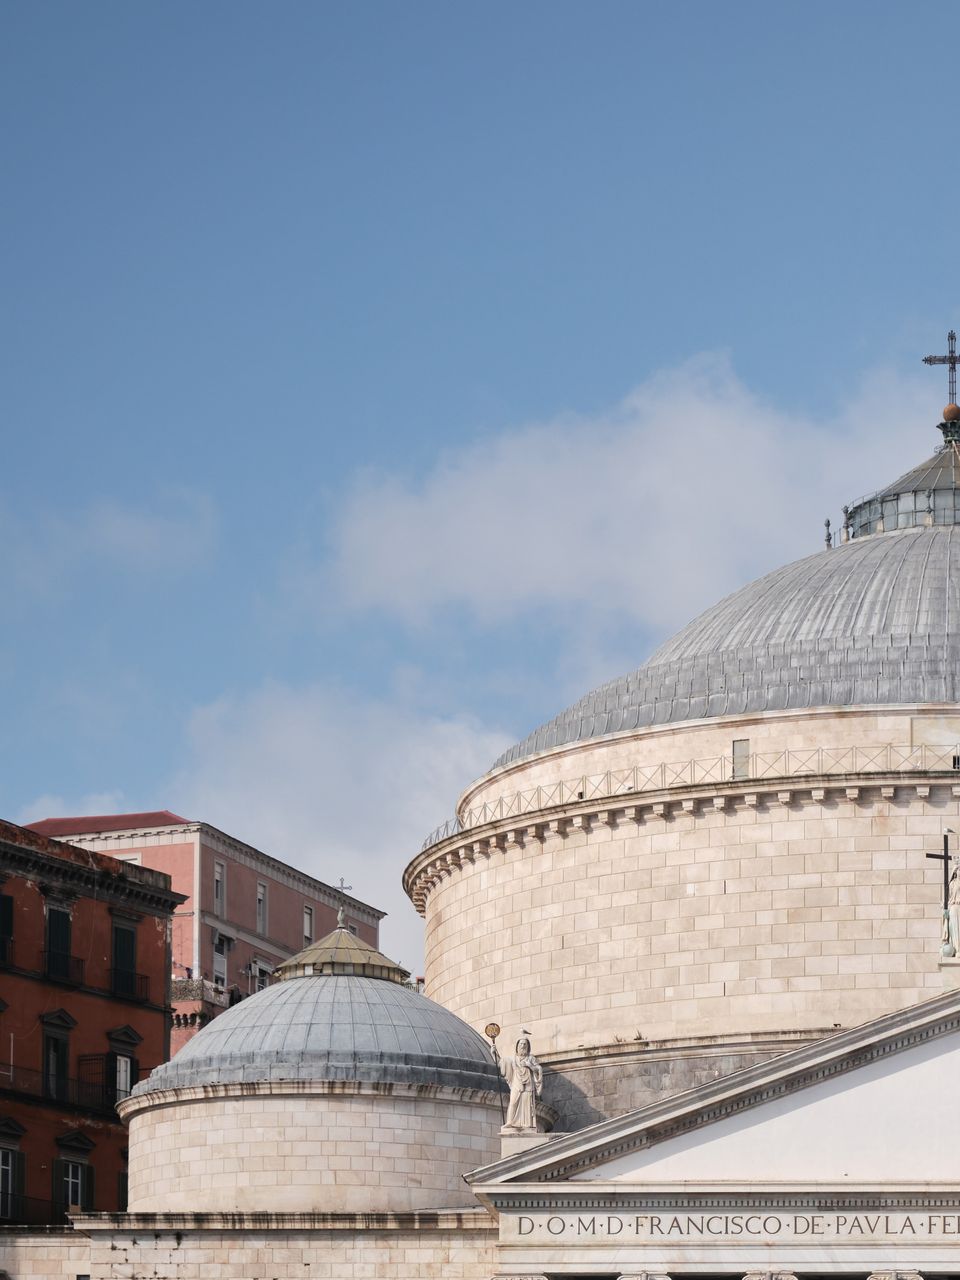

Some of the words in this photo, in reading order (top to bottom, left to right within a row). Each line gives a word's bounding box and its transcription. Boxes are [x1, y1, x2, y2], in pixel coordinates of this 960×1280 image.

[517, 1216, 535, 1235] D
[546, 1216, 566, 1235] O
[577, 1216, 596, 1235] M
[606, 1216, 624, 1235] D
[635, 1215, 782, 1235] FRANCISCO
[793, 1215, 825, 1235] DE
[835, 1215, 917, 1235] PAVLA
